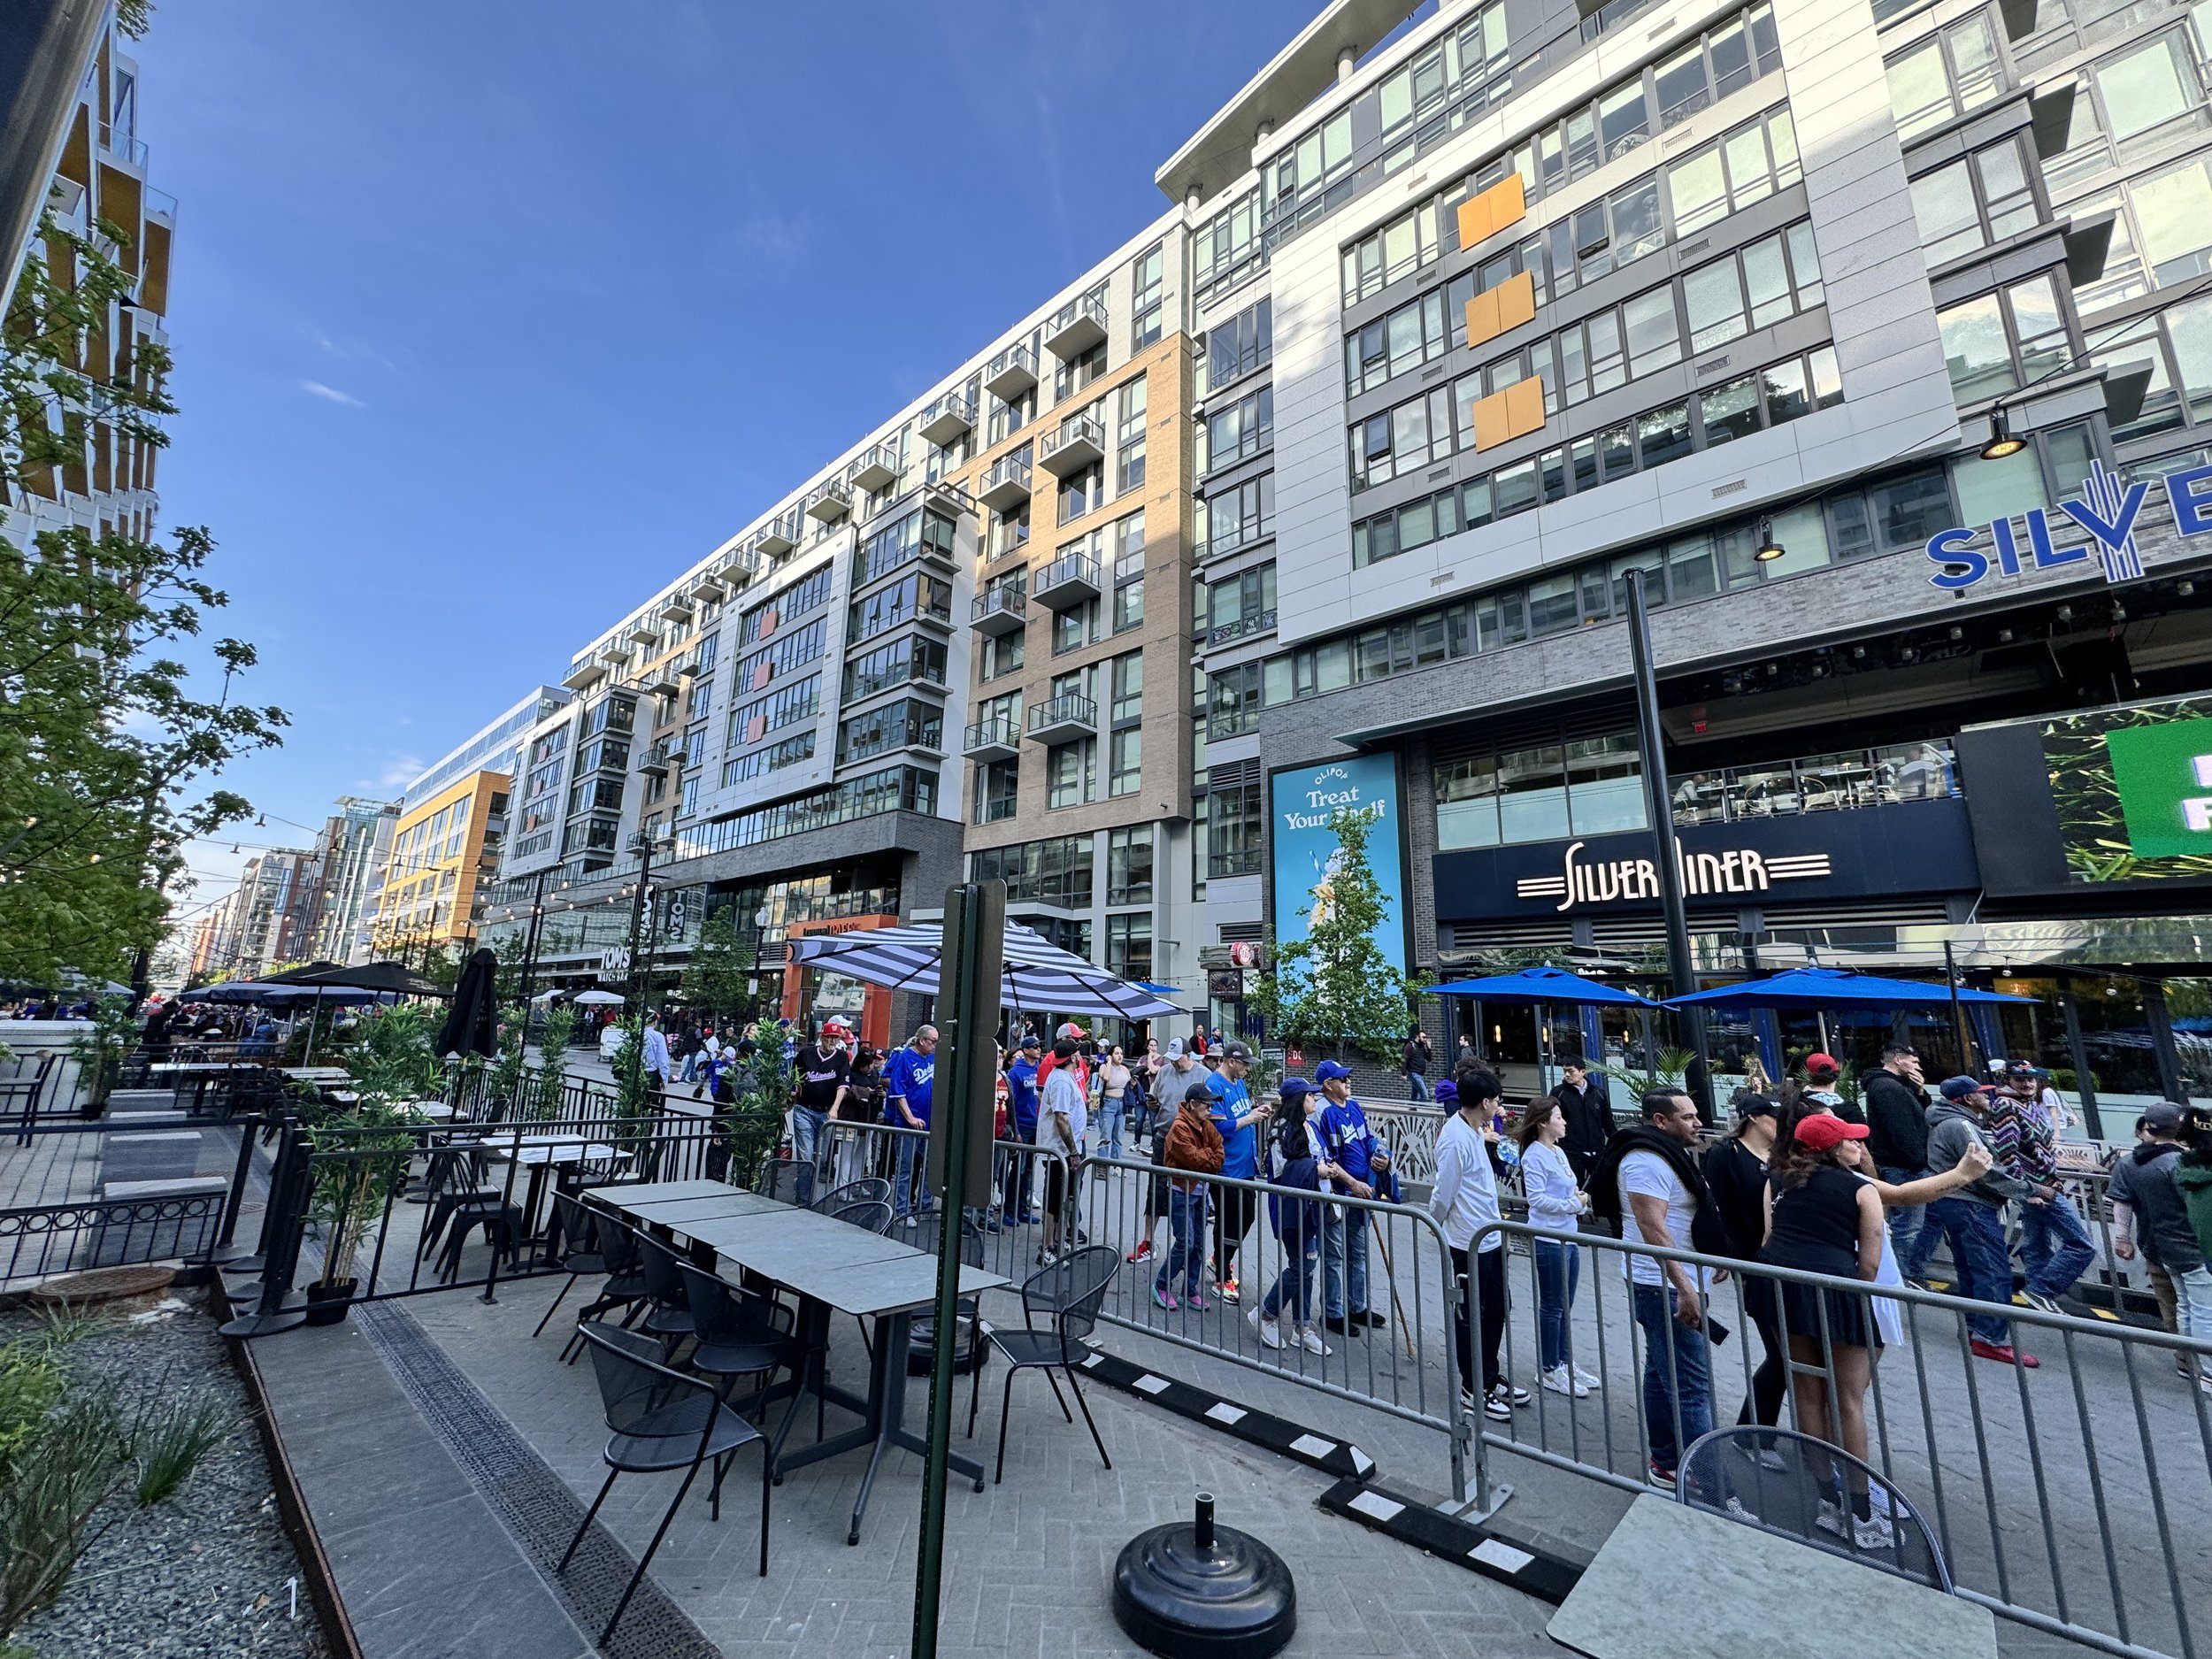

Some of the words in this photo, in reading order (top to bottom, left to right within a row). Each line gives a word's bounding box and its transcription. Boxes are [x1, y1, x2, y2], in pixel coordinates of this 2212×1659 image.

[1314, 767, 1348, 786] OLIPOP
[1305, 785, 1360, 809] Treat
[1284, 812, 1327, 830] Your
[1556, 841, 1660, 912] SILVER
[1675, 836, 1769, 898] INER
